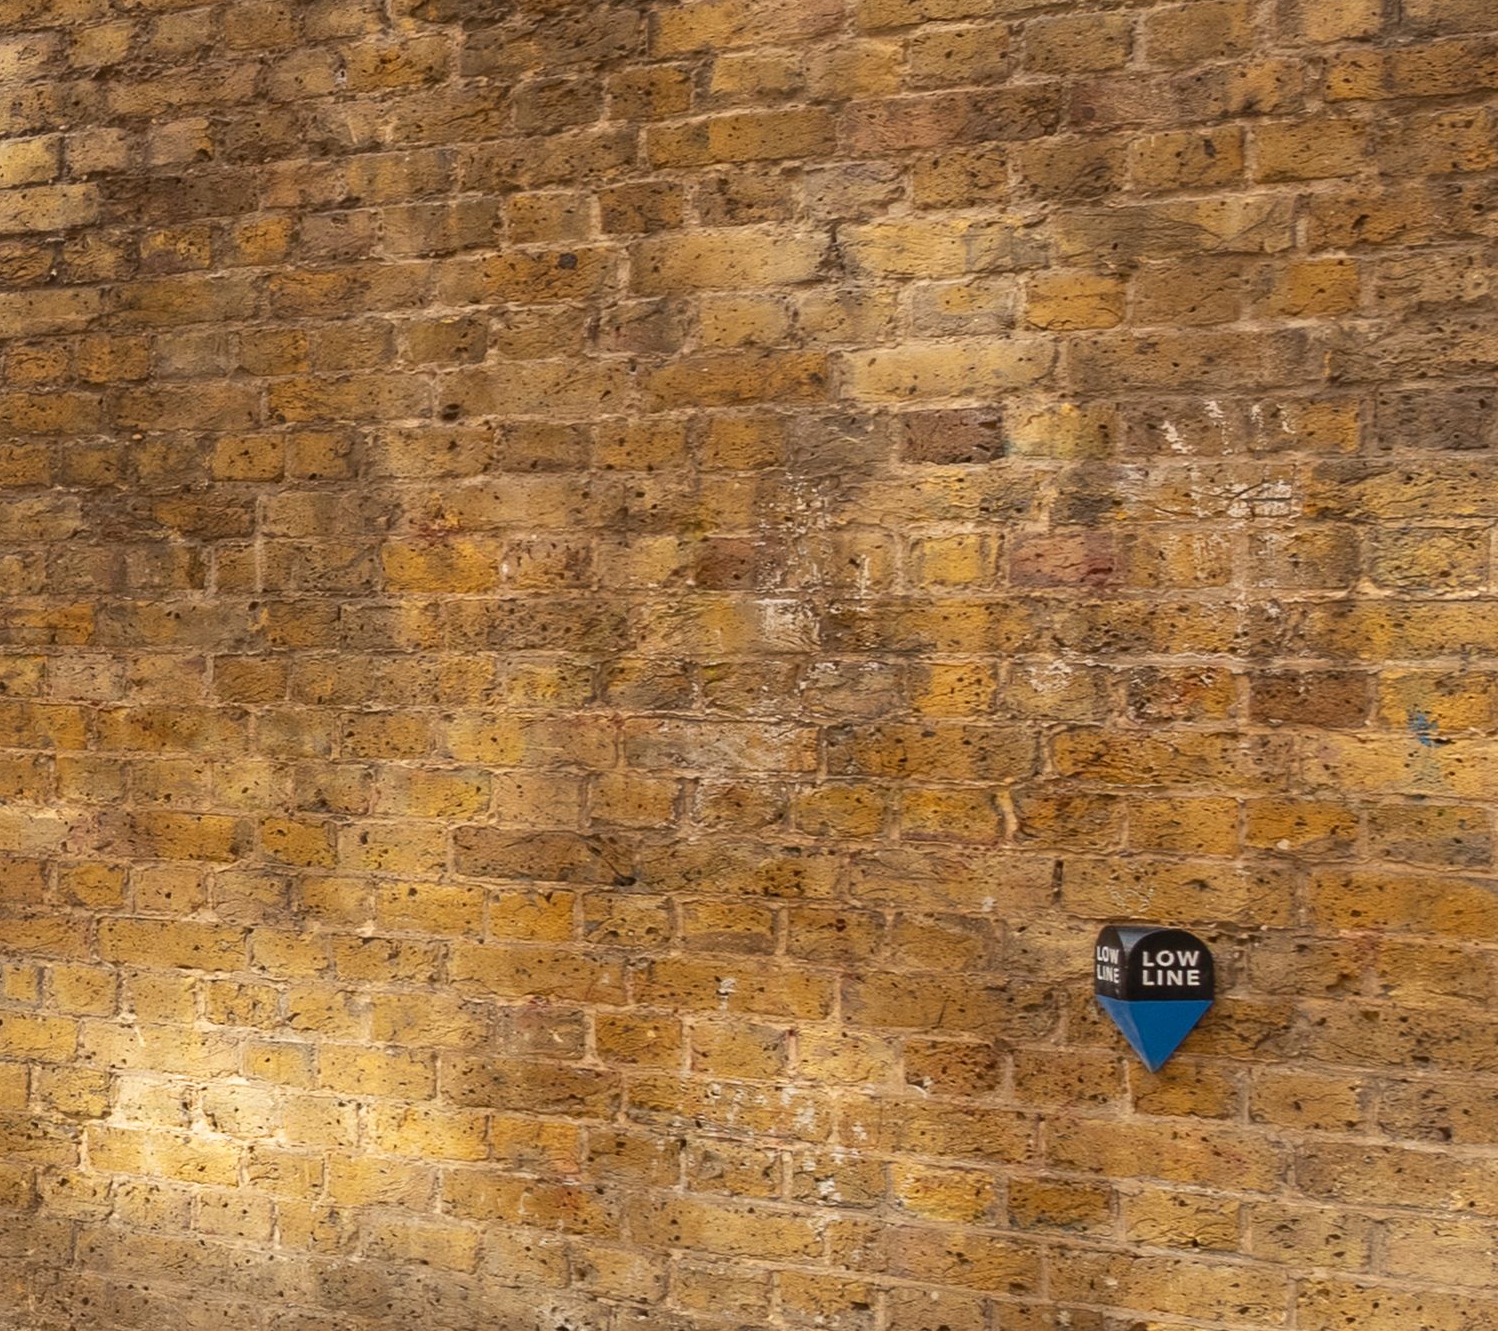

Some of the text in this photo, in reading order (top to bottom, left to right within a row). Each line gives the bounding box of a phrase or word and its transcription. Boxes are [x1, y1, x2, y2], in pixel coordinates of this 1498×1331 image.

[1096, 946, 1120, 965] LOW
[1142, 950, 1201, 967] LOW
[1096, 964, 1120, 984] LINE
[1142, 969, 1201, 986] LINE
